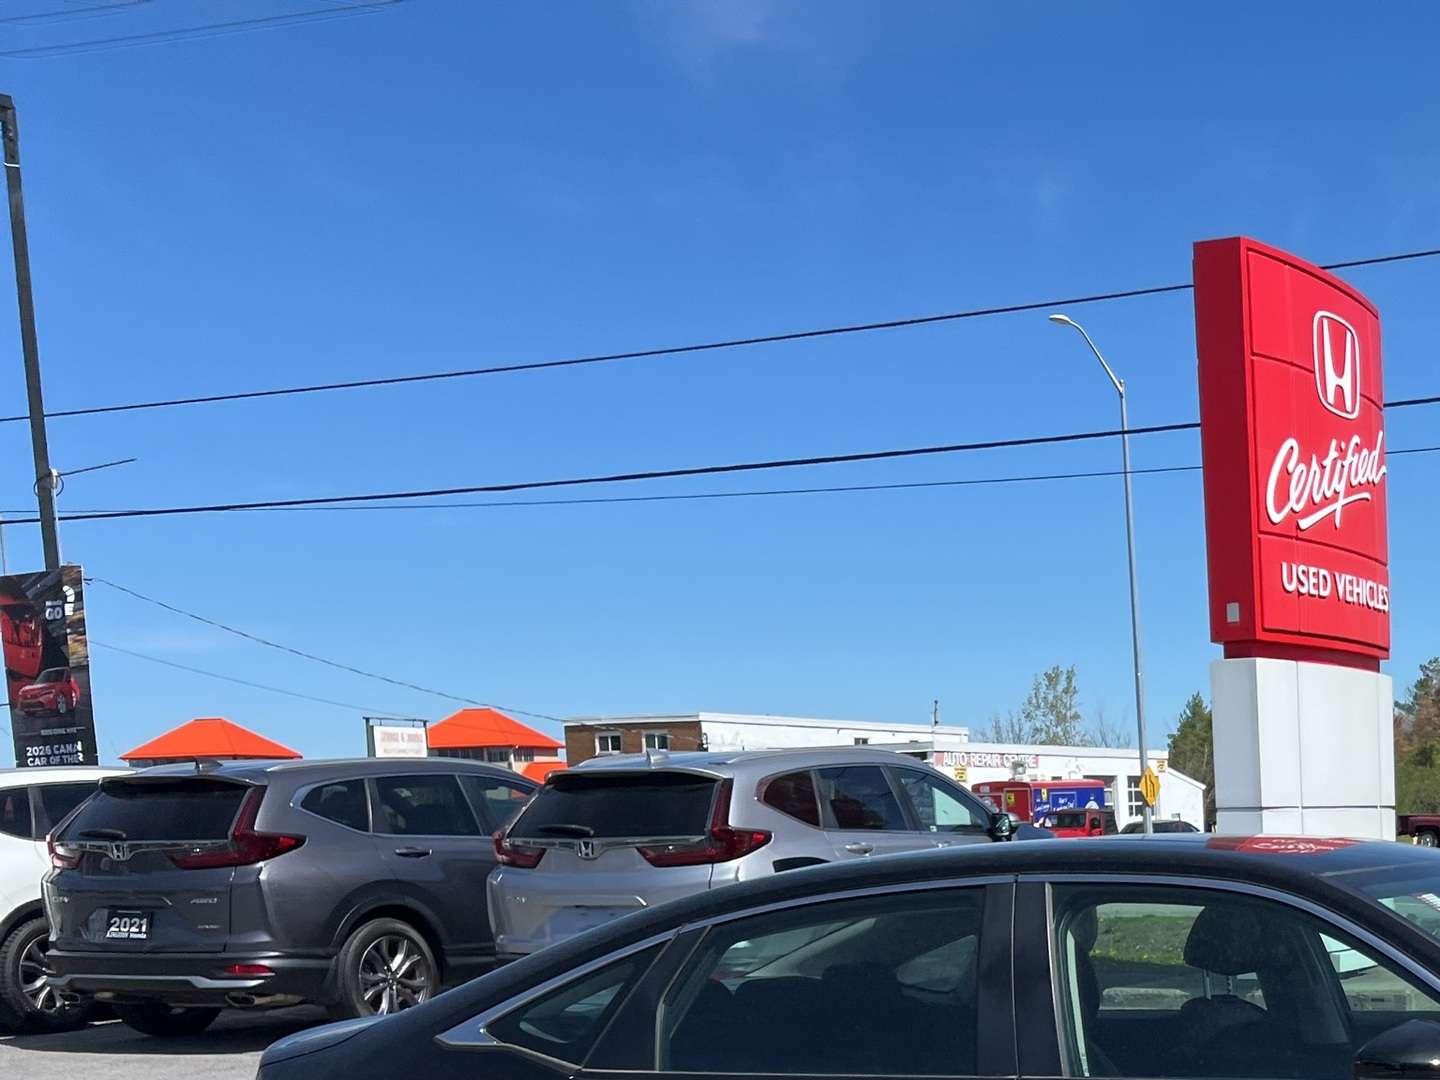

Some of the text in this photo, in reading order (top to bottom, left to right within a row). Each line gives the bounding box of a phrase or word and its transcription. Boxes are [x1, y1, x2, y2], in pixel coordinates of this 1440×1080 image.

[1266, 430, 1387, 529] Certified
[1281, 562, 1389, 613] USED VEHICLES
[27, 757, 48, 766] CAR
[943, 752, 967, 766] AUTO
[970, 753, 1001, 768] REPAIR
[110, 917, 147, 932] 2021
